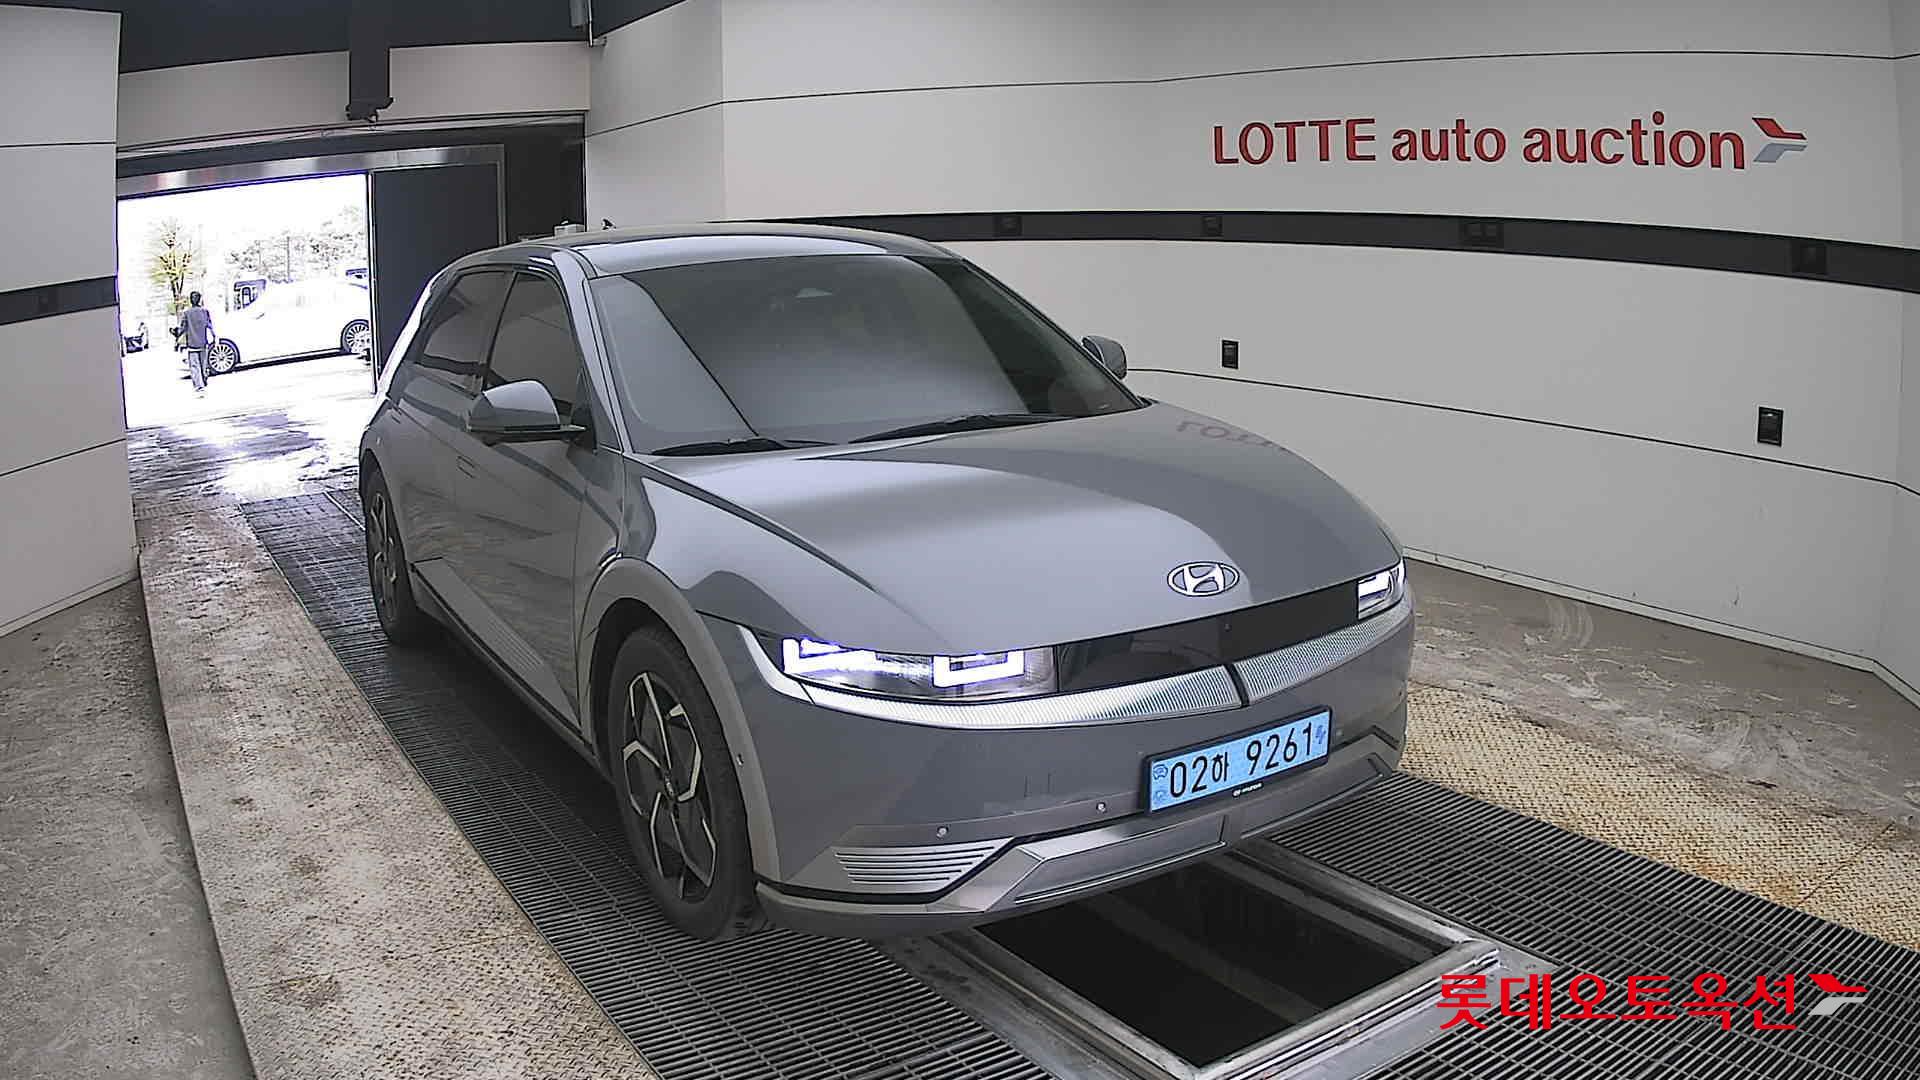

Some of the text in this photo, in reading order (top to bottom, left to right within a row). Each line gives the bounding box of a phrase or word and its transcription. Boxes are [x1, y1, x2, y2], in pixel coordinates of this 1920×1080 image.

[1213, 110, 1746, 170] LOTTE auto auction
[1170, 721, 1313, 798] 02하 9261
